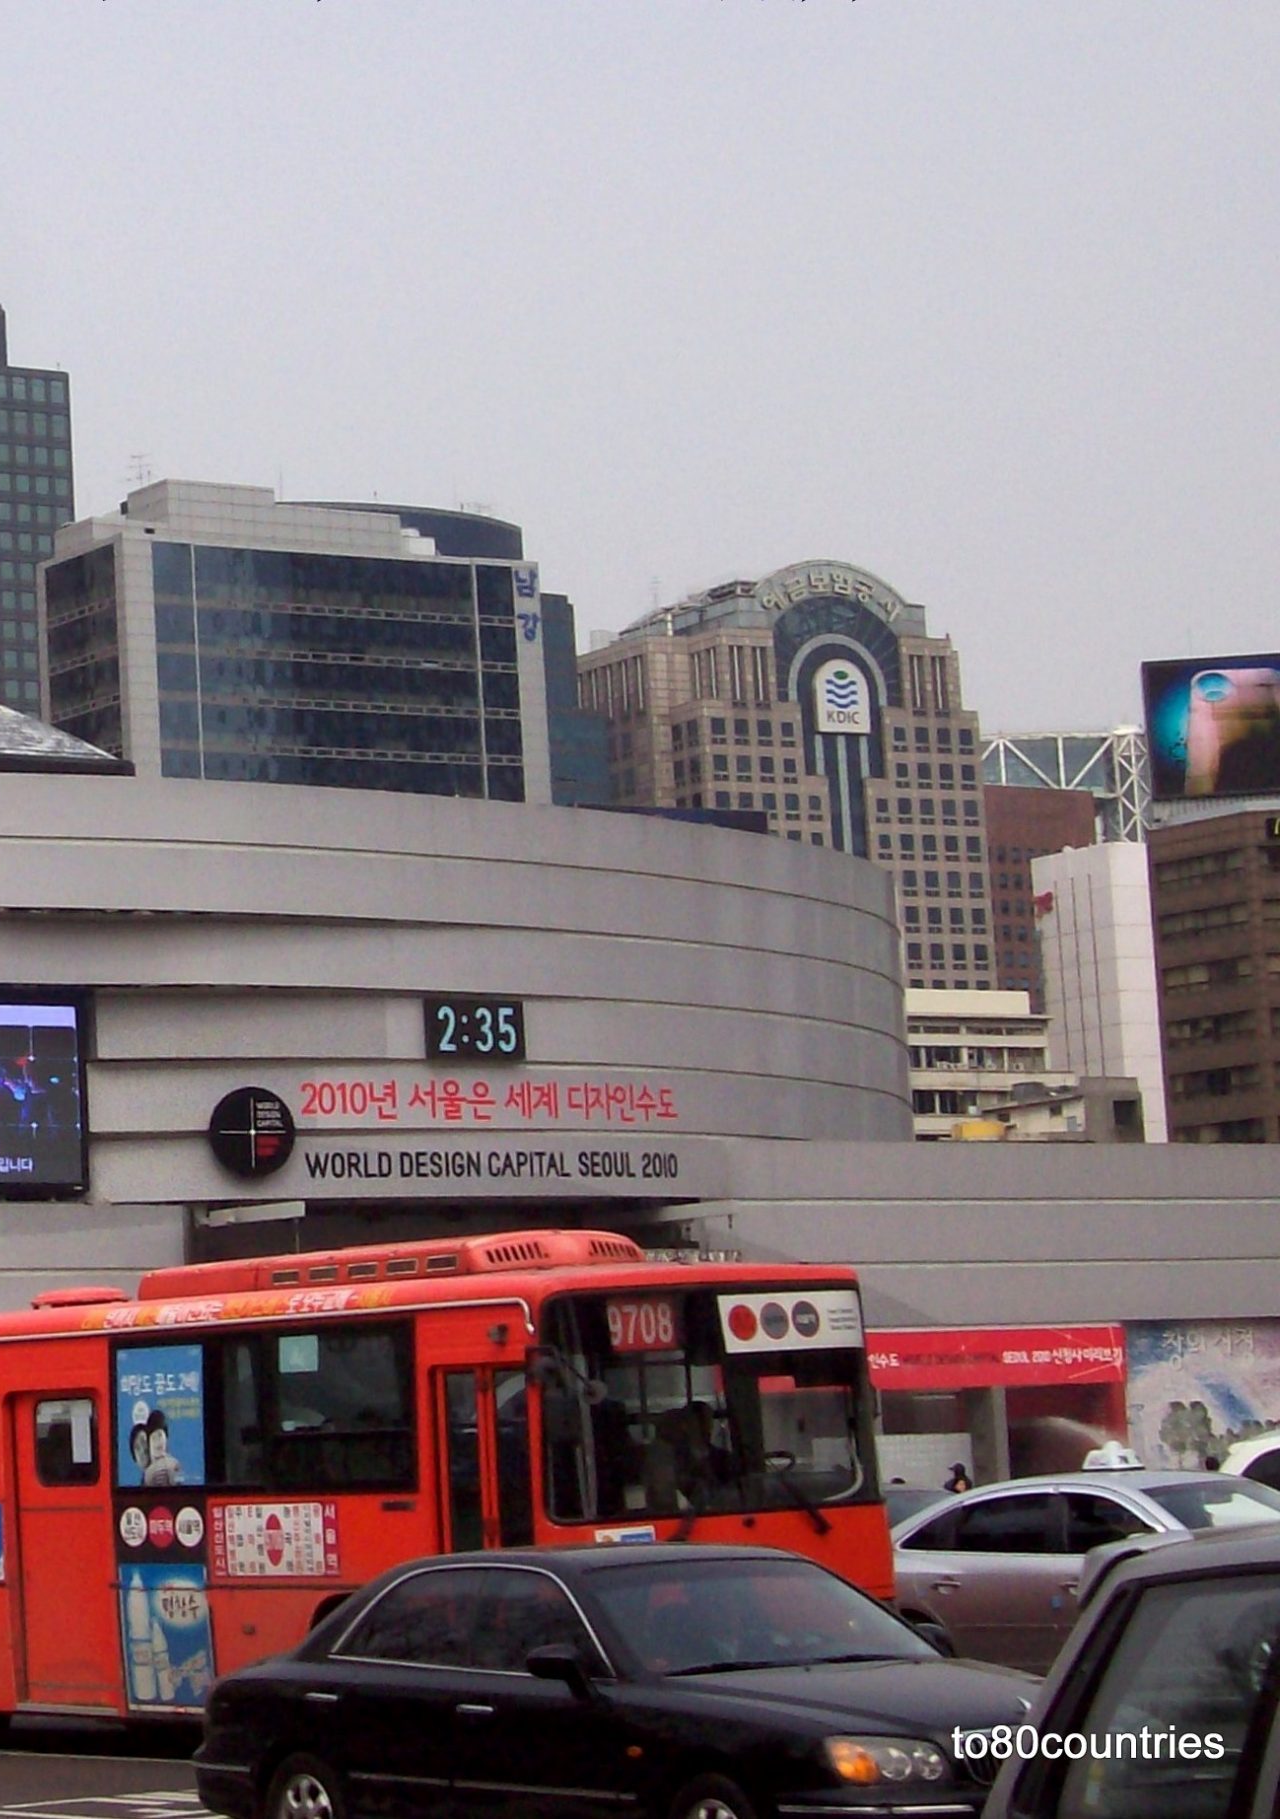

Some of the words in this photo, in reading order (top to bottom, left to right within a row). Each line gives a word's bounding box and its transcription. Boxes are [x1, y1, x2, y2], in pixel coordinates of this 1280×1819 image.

[826, 710, 861, 725] KDIC
[437, 1005, 517, 1053] 2:35
[301, 1080, 397, 1120] 2010년
[409, 1079, 496, 1121] 서울은
[505, 1080, 559, 1119] 세계
[567, 1082, 679, 1122] 디자인수도
[305, 1152, 392, 1178] WORLD
[400, 1151, 481, 1178] DESIGN
[488, 1152, 570, 1178] CAPITAL
[578, 1152, 636, 1178] SEOUL
[642, 1152, 678, 1179] 2010
[607, 1302, 673, 1346] 9708
